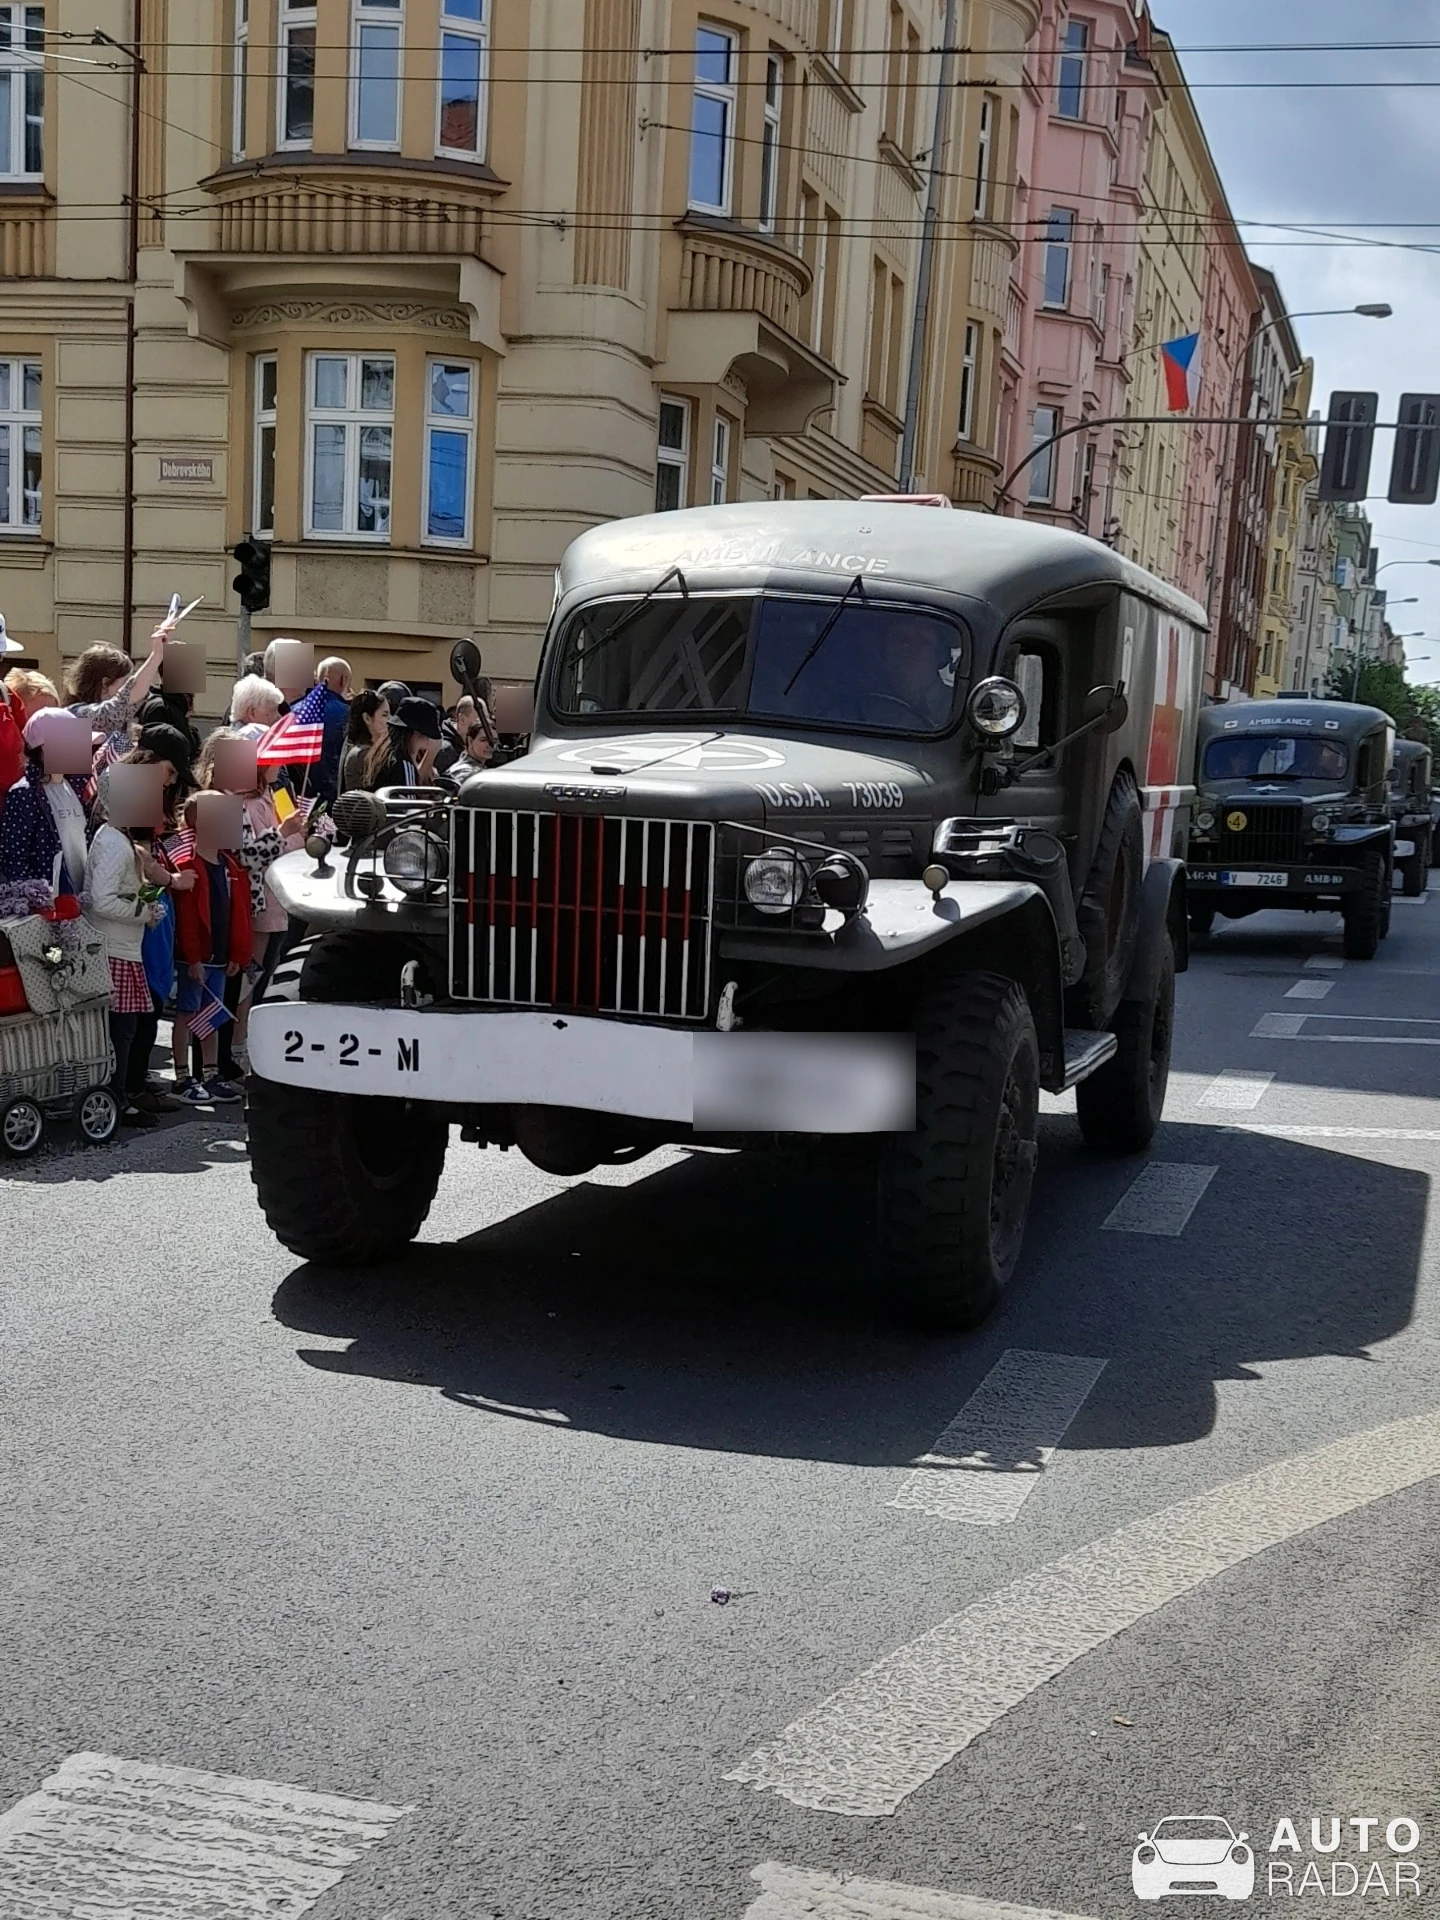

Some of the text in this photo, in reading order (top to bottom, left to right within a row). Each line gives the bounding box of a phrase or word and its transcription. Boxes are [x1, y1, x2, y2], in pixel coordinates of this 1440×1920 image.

[162, 461, 211, 478] Dobrovského
[673, 546, 890, 574] AMBULANCE
[1248, 717, 1313, 727] AMBULANCE
[755, 782, 904, 808] U.S.A. 73039
[1232, 815, 1241, 829] 4
[1257, 873, 1283, 885] 7246
